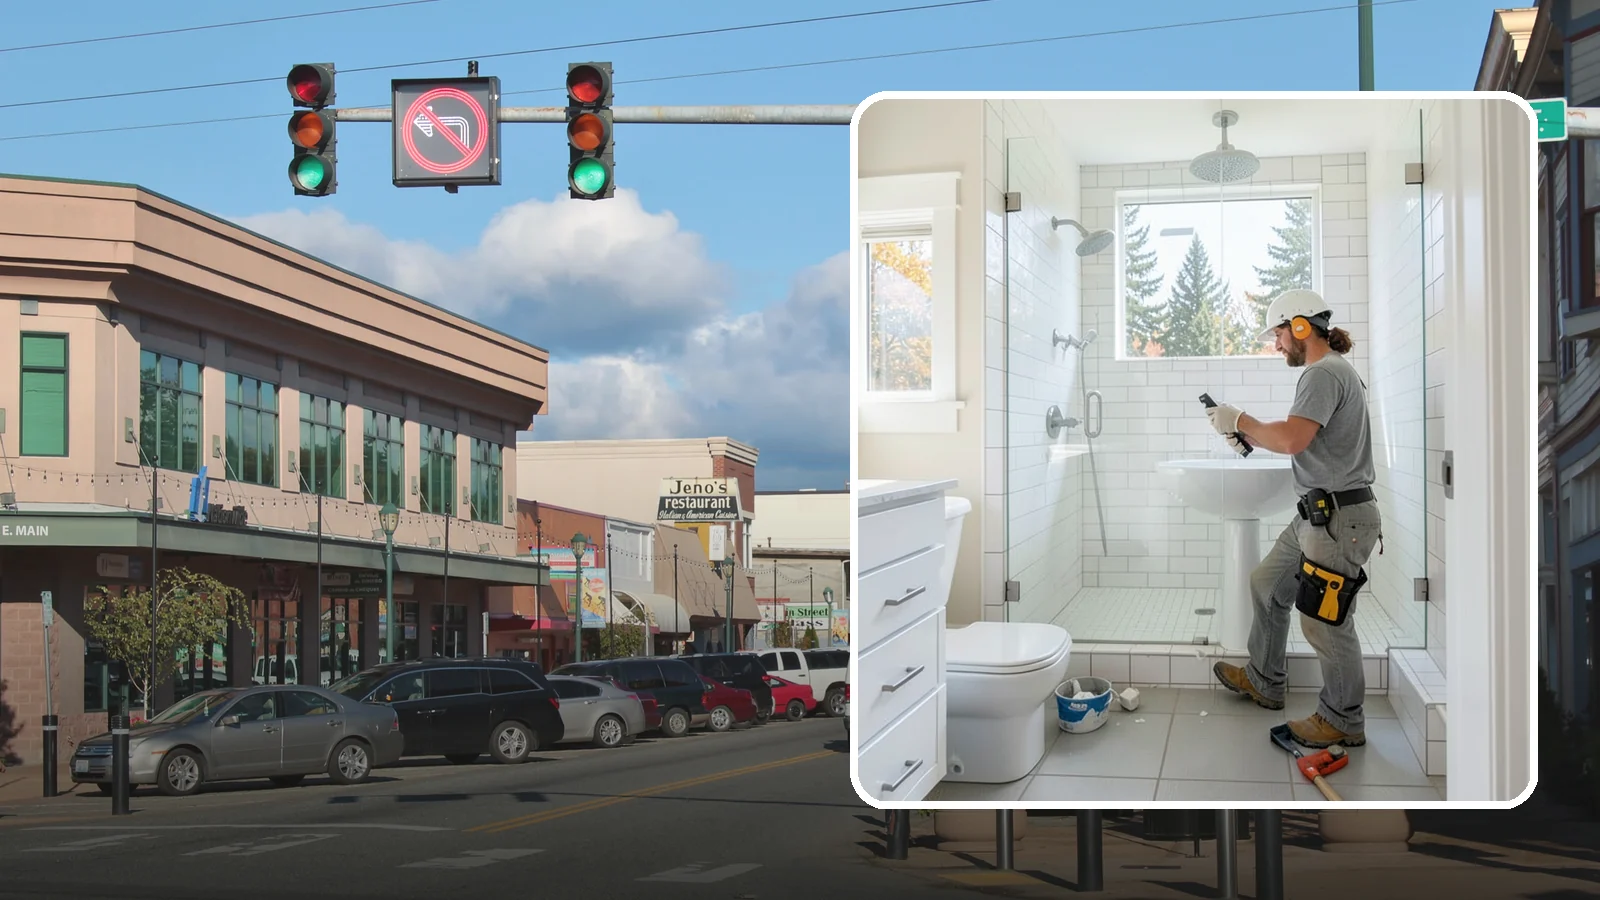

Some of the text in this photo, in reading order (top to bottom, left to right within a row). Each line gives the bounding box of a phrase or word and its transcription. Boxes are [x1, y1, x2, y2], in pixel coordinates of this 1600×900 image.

[669, 480, 728, 494] Jeno's
[665, 496, 731, 509] restaurant
[658, 509, 681, 520] Italian
[686, 509, 715, 520] American
[715, 509, 738, 519] Cuisine
[2, 525, 49, 536] E. MAIN
[785, 607, 828, 617] in Street
[791, 619, 824, 627] lass
